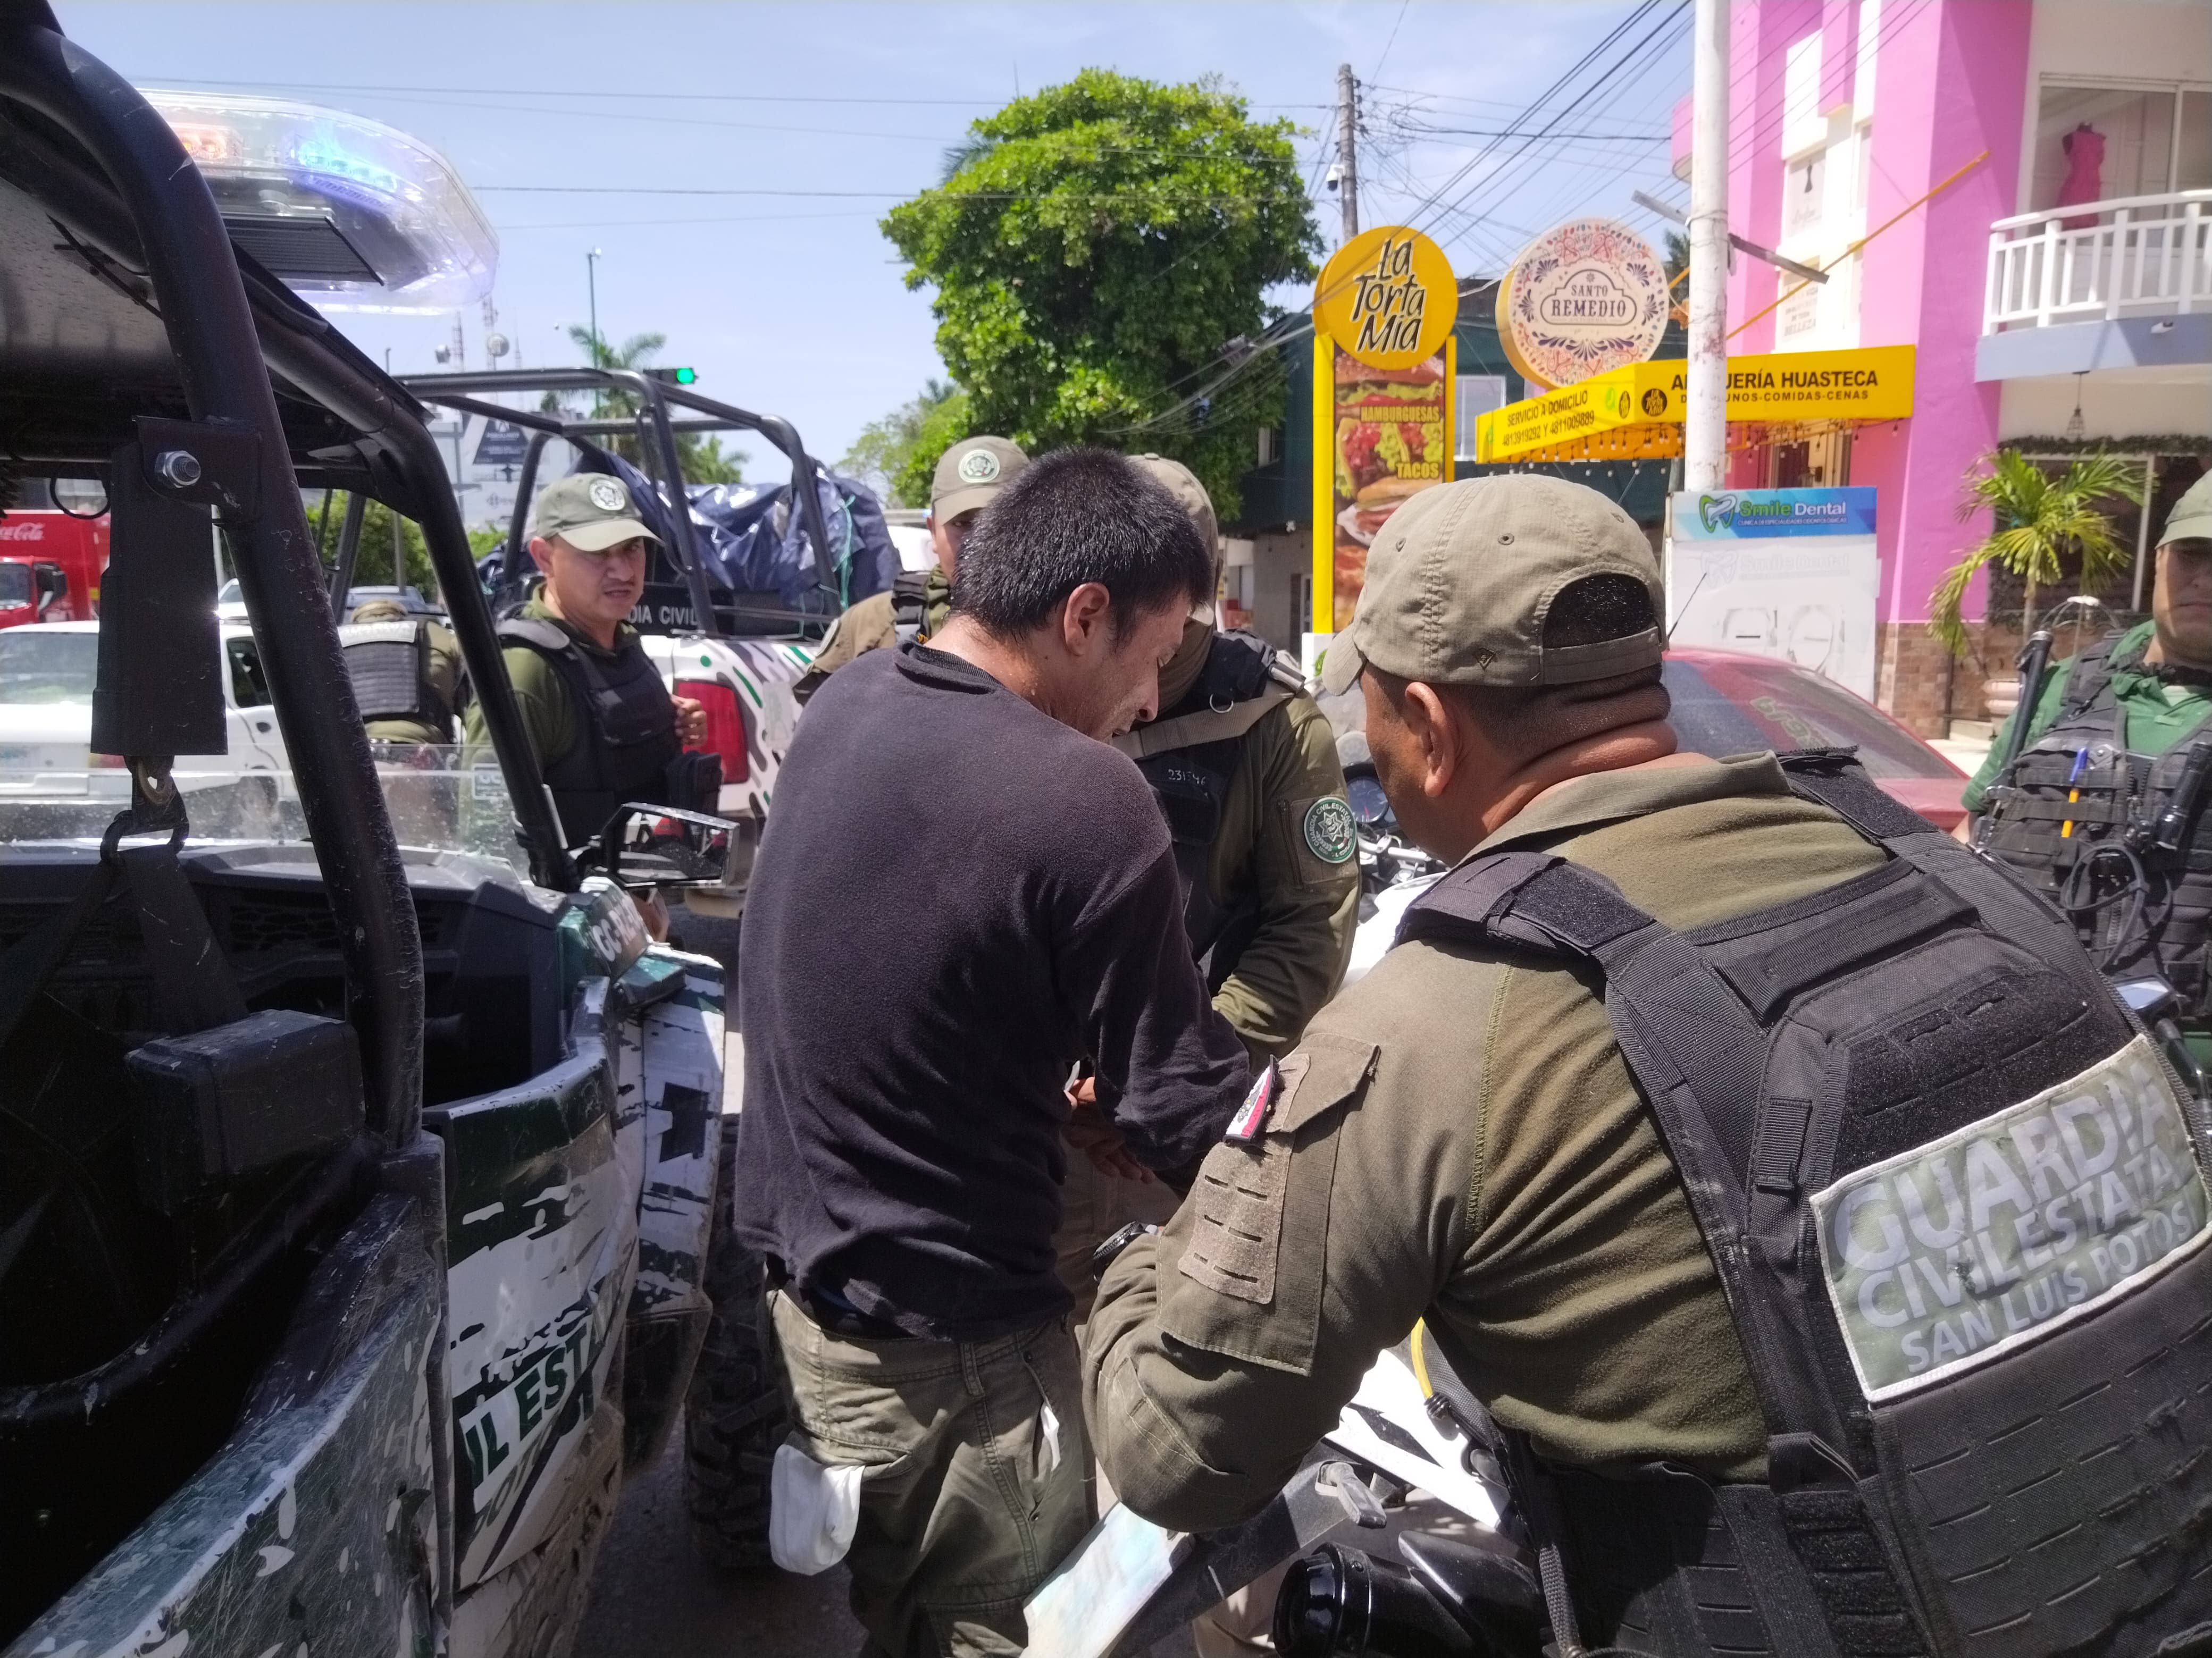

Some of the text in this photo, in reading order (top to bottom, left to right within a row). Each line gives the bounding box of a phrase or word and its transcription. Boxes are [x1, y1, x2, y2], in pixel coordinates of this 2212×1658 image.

[1378, 238, 1413, 281] La
[1352, 274, 1426, 322] Torta
[1571, 285, 1608, 297] SANTO
[1552, 299, 1626, 317] REMEDIO
[1782, 371, 1878, 388] HUASTECA
[1361, 406, 1439, 422] HAMBURGUESAS
[1507, 390, 1588, 427] SERVICIO A DOMICILIO
[1543, 423, 1548, 436] Y
[1396, 462, 1439, 478] TACOS
[1740, 500, 1846, 517] Smile Dental
[659, 605, 699, 626] CIVIL
[1310, 814, 1318, 846] GUARDIA
[1316, 803, 1331, 815] CIVIL
[1331, 803, 1351, 823] ESTATAL
[1834, 1062, 2176, 1271] GUARDIA
[1858, 1231, 2020, 1328] CIVIL
[1901, 1302, 1996, 1373] SAN
[2004, 1260, 2088, 1331] LUIS
[466, 1411, 509, 1489] IL
